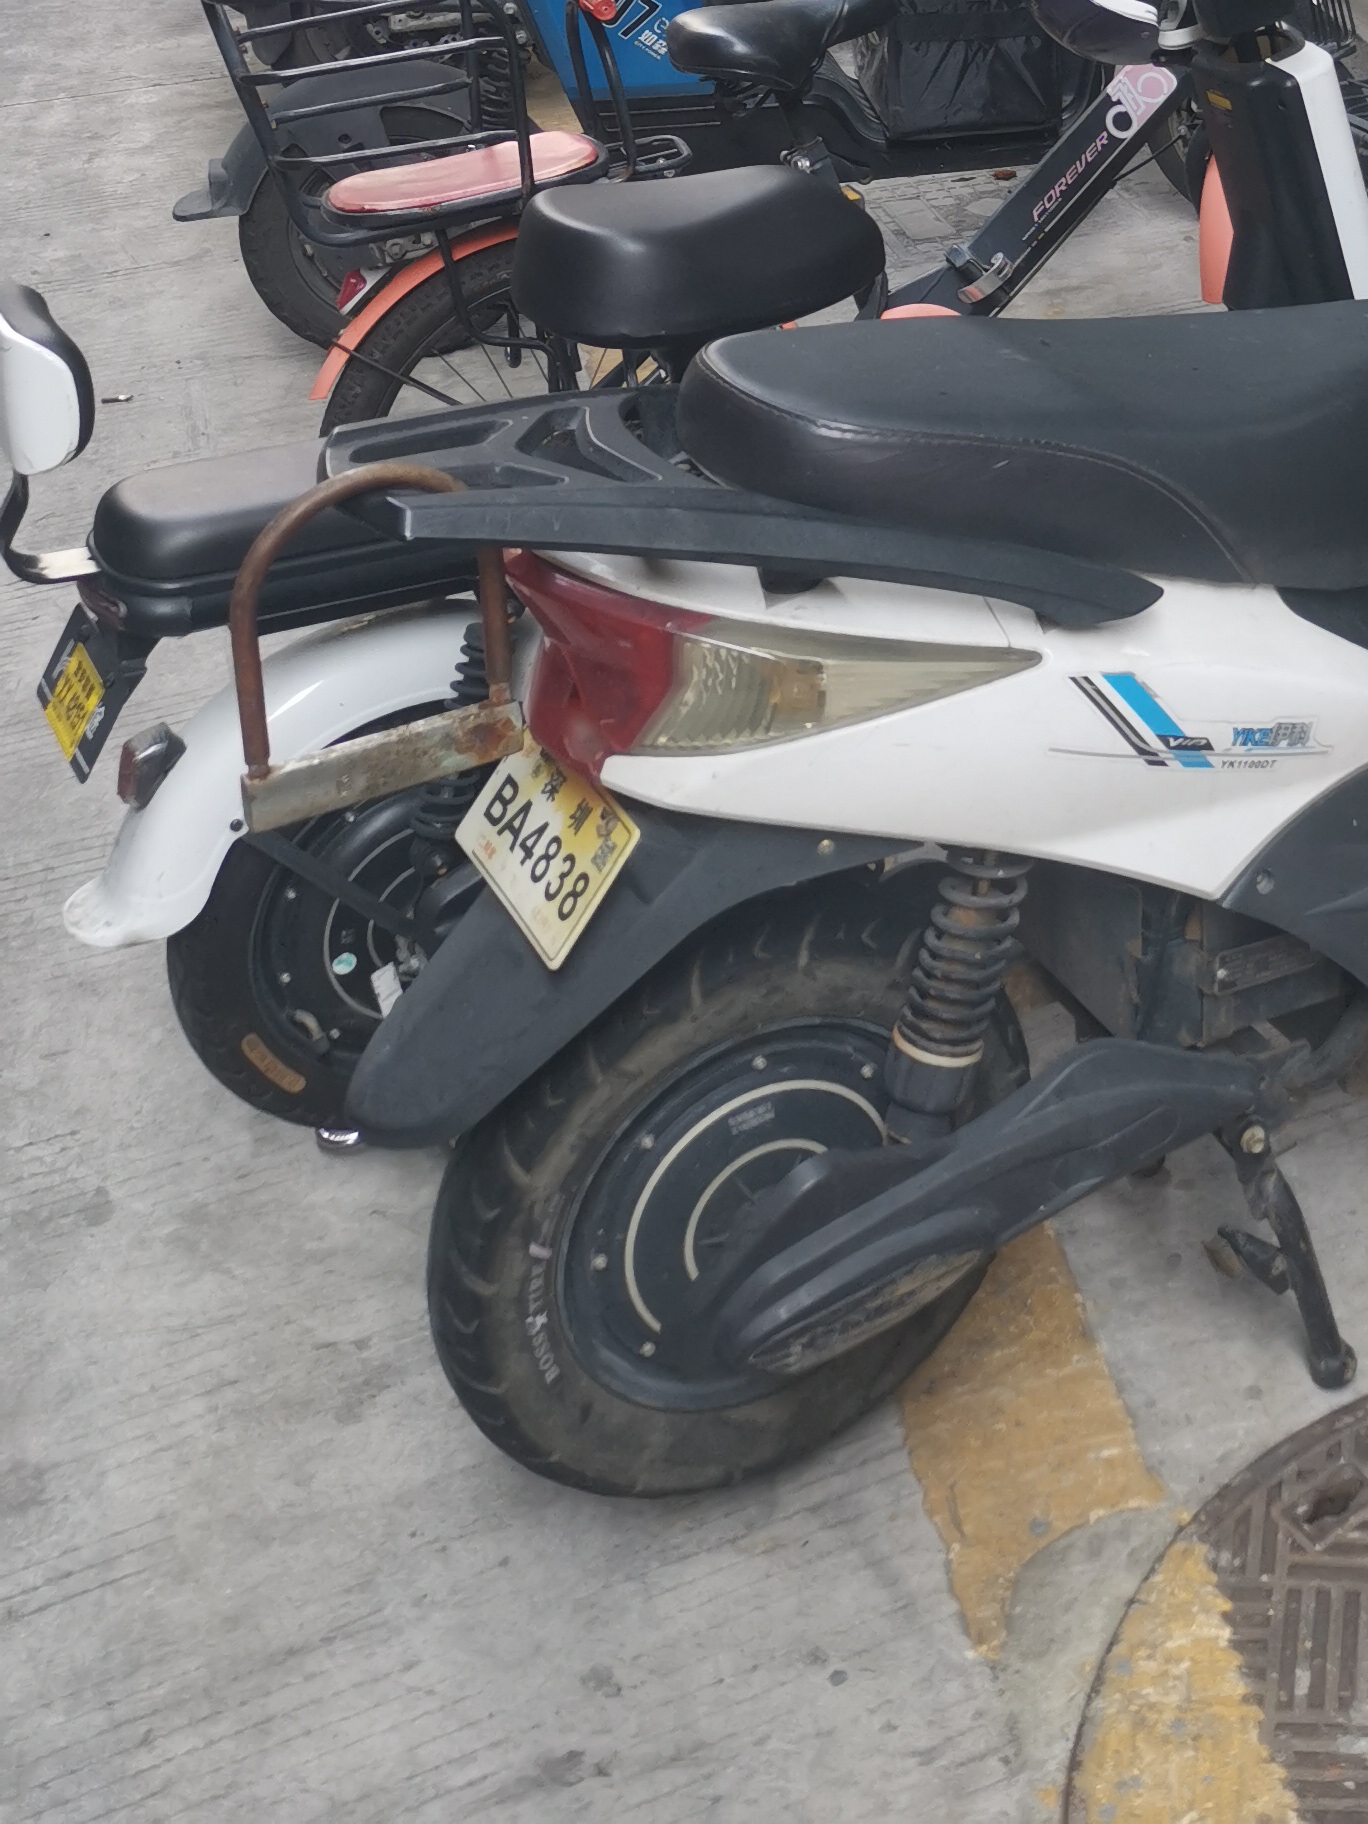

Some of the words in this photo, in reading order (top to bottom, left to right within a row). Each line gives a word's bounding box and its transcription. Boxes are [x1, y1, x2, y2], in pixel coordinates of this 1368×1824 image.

[1032, 130, 1109, 222] FOREVER
[1167, 737, 1208, 748] VIP
[541, 767, 594, 836] 深圳
[484, 773, 590, 921] BA4838
